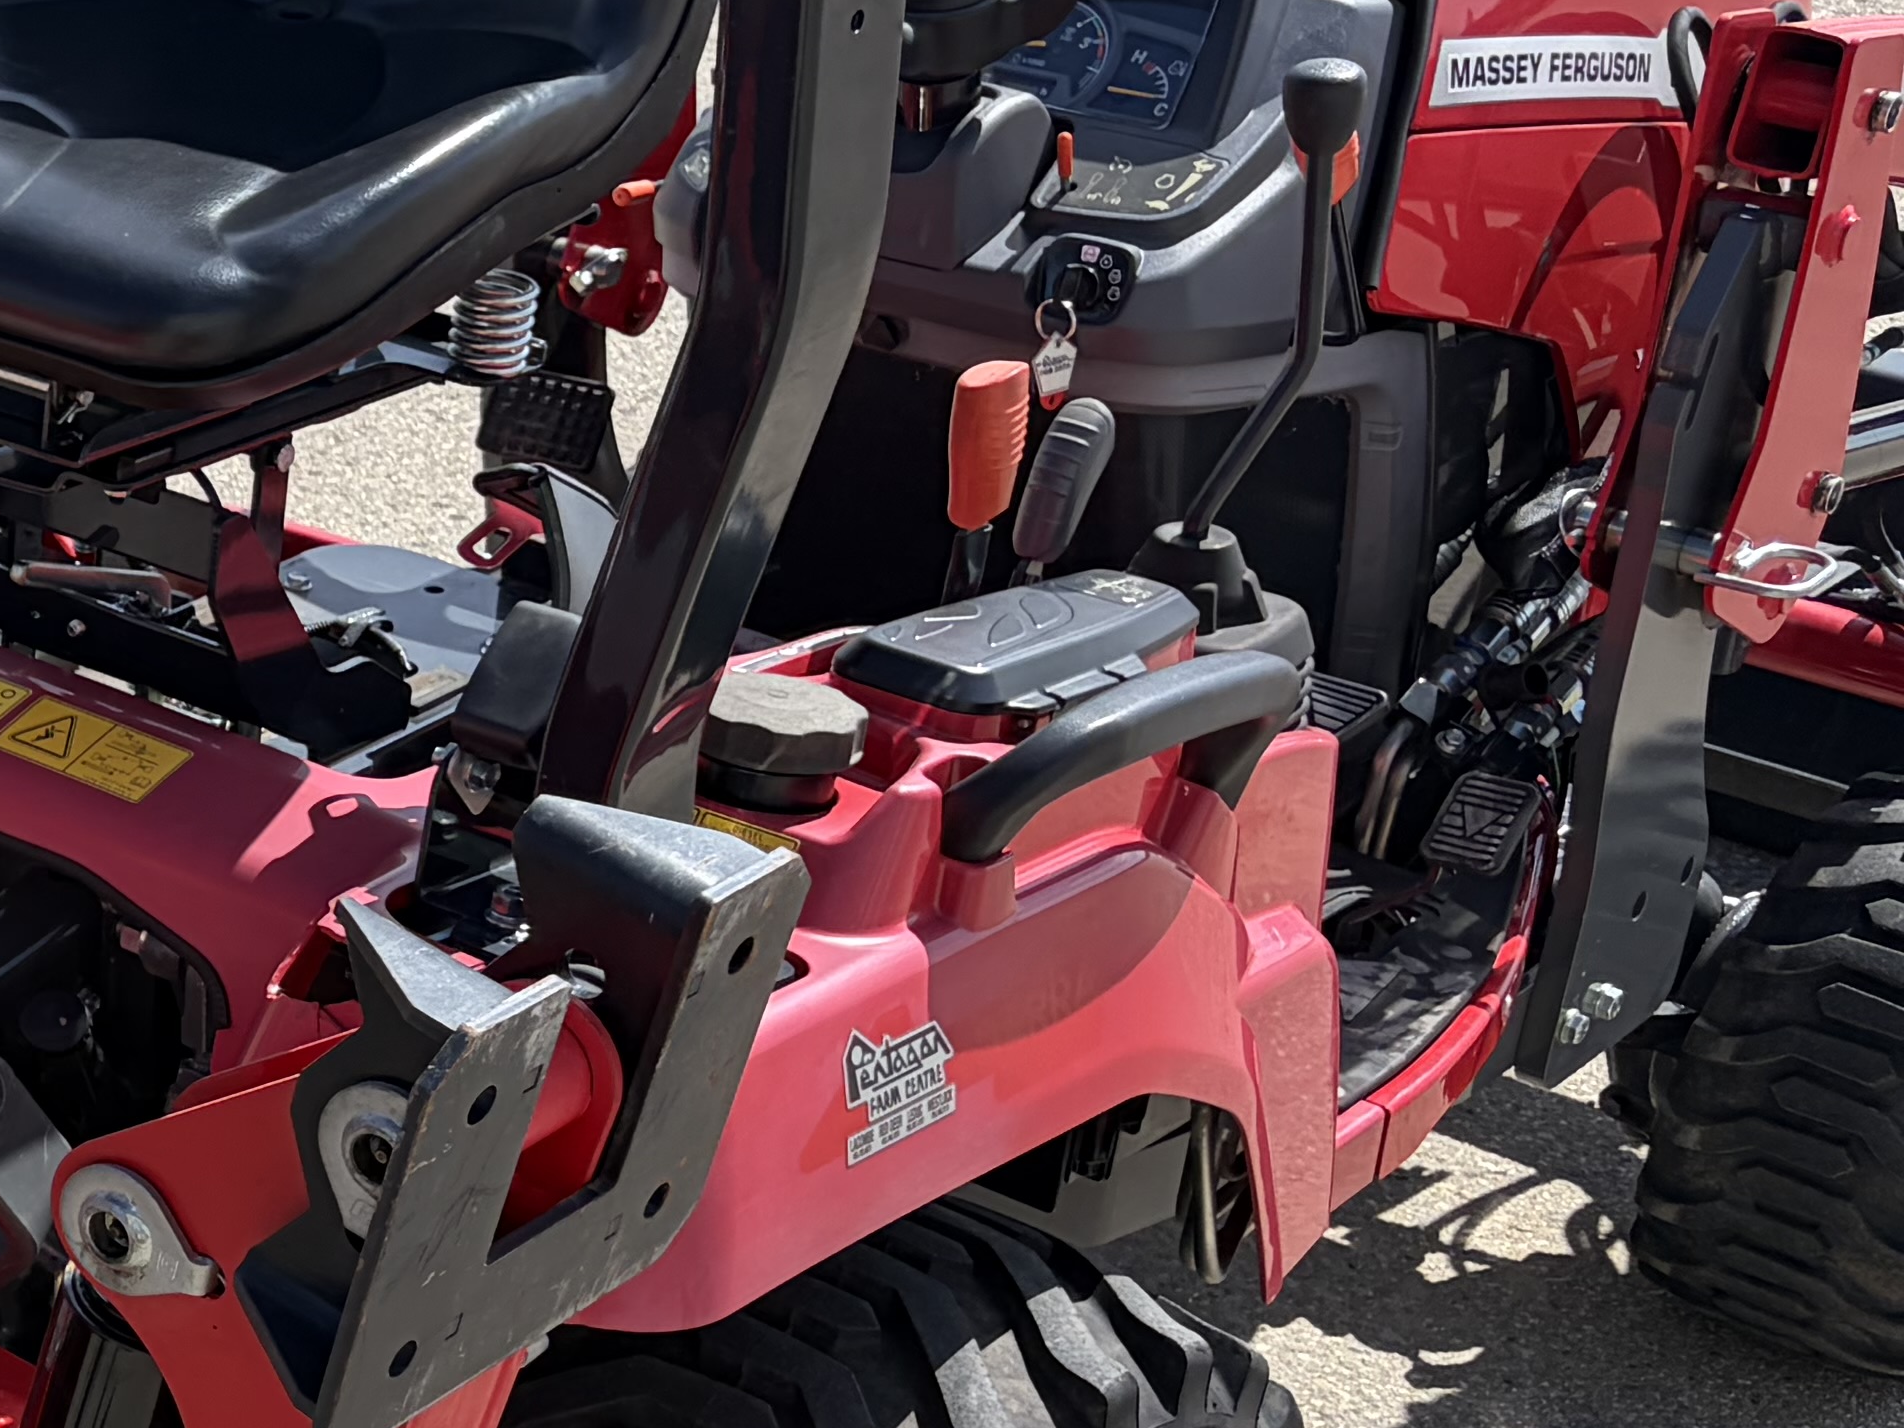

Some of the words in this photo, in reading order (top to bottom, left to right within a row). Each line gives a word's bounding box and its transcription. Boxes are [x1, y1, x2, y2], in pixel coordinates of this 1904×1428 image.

[1450, 52, 1543, 89] MASSEY
[1548, 52, 1652, 83] FERGUSON
[845, 1025, 950, 1103] Pentagon
[870, 1085, 901, 1117] FARM
[905, 1064, 944, 1099] CENTRE
